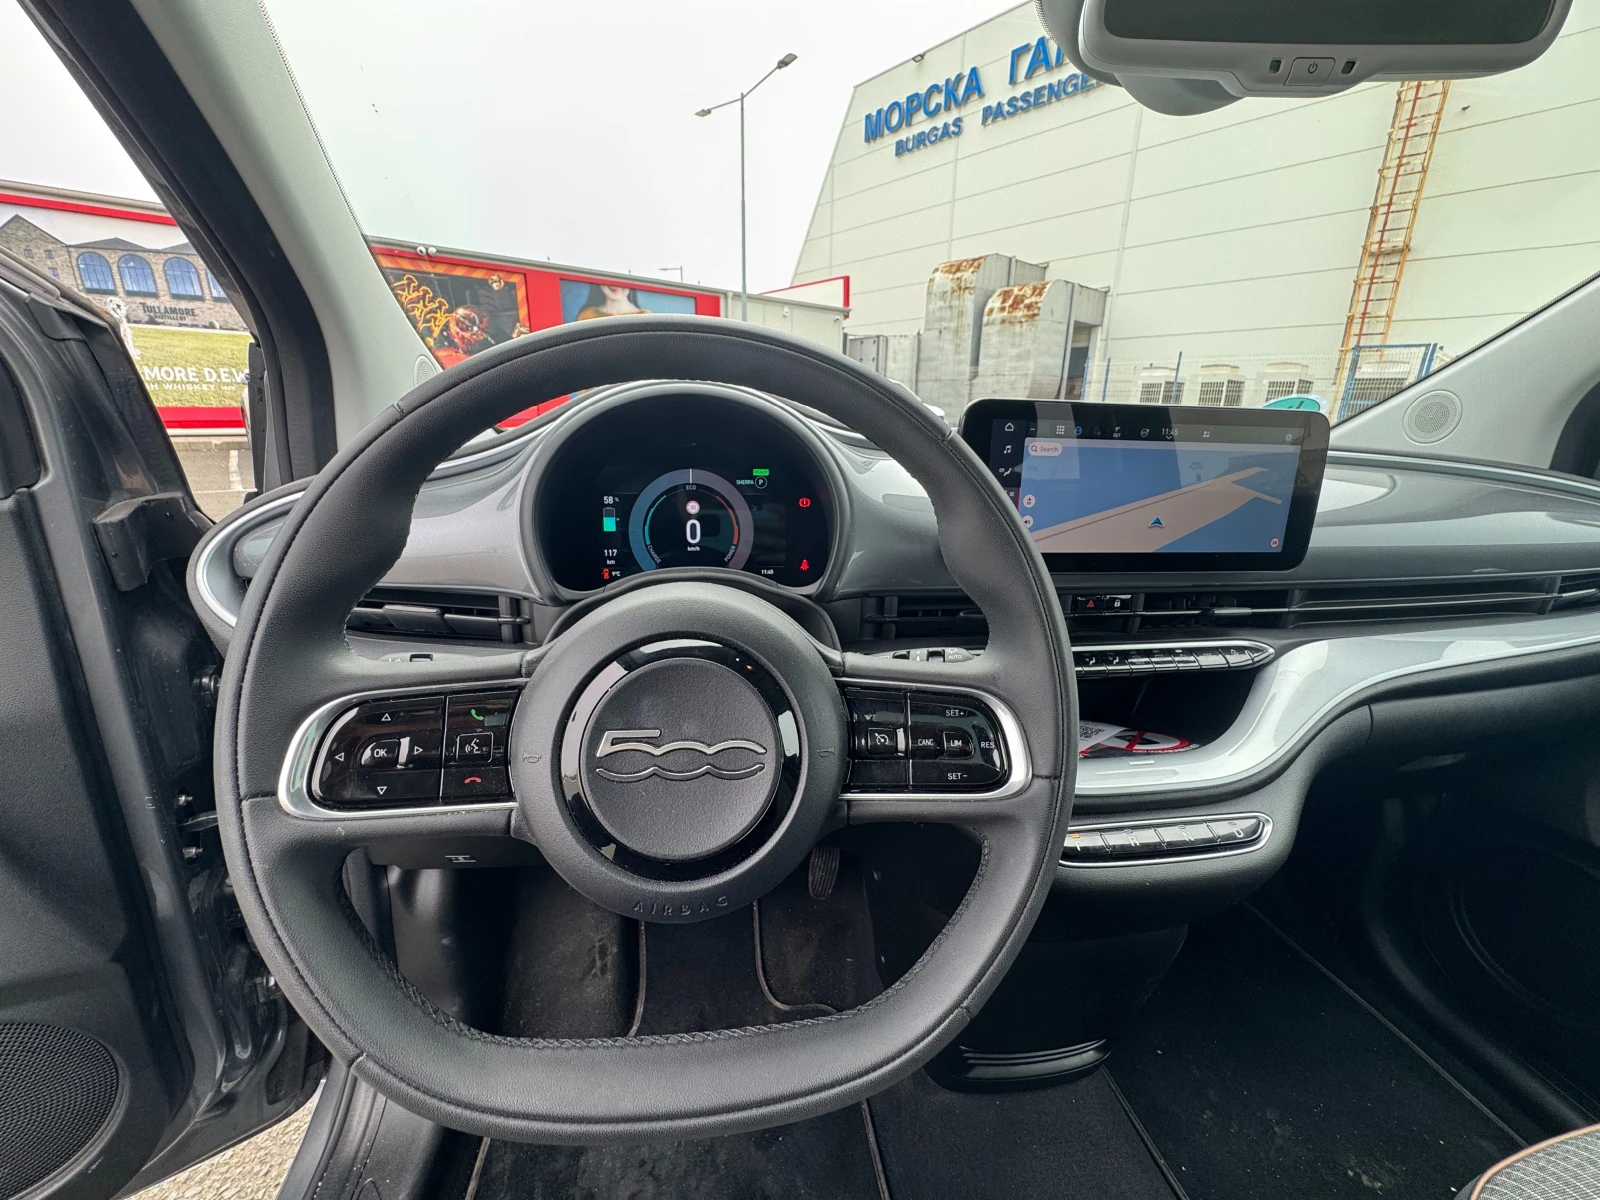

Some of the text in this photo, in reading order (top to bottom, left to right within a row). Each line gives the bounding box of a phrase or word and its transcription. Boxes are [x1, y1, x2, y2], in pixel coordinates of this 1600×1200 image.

[864, 66, 985, 143] МОРСКА
[895, 72, 1100, 157] BURGAS PASSENGE
[139, 302, 197, 317] TULLAMORE
[163, 383, 215, 391] WHISKEY
[1162, 428, 1178, 436] 11:45
[603, 496, 614, 504] 58
[686, 519, 701, 544] 0
[604, 549, 618, 557] 117
[647, 545, 661, 564] CHARGE
[724, 545, 737, 562] POWER
[918, 738, 934, 746] CANC
[950, 739, 962, 747] LIM
[980, 741, 995, 749] RES
[374, 748, 387, 758] OK
[596, 729, 768, 783] 500
[1182, 831, 1194, 842] N
[1233, 828, 1243, 838] D
[1075, 841, 1083, 851] P
[1128, 836, 1139, 847] R
[633, 895, 728, 916] AIRBAG
